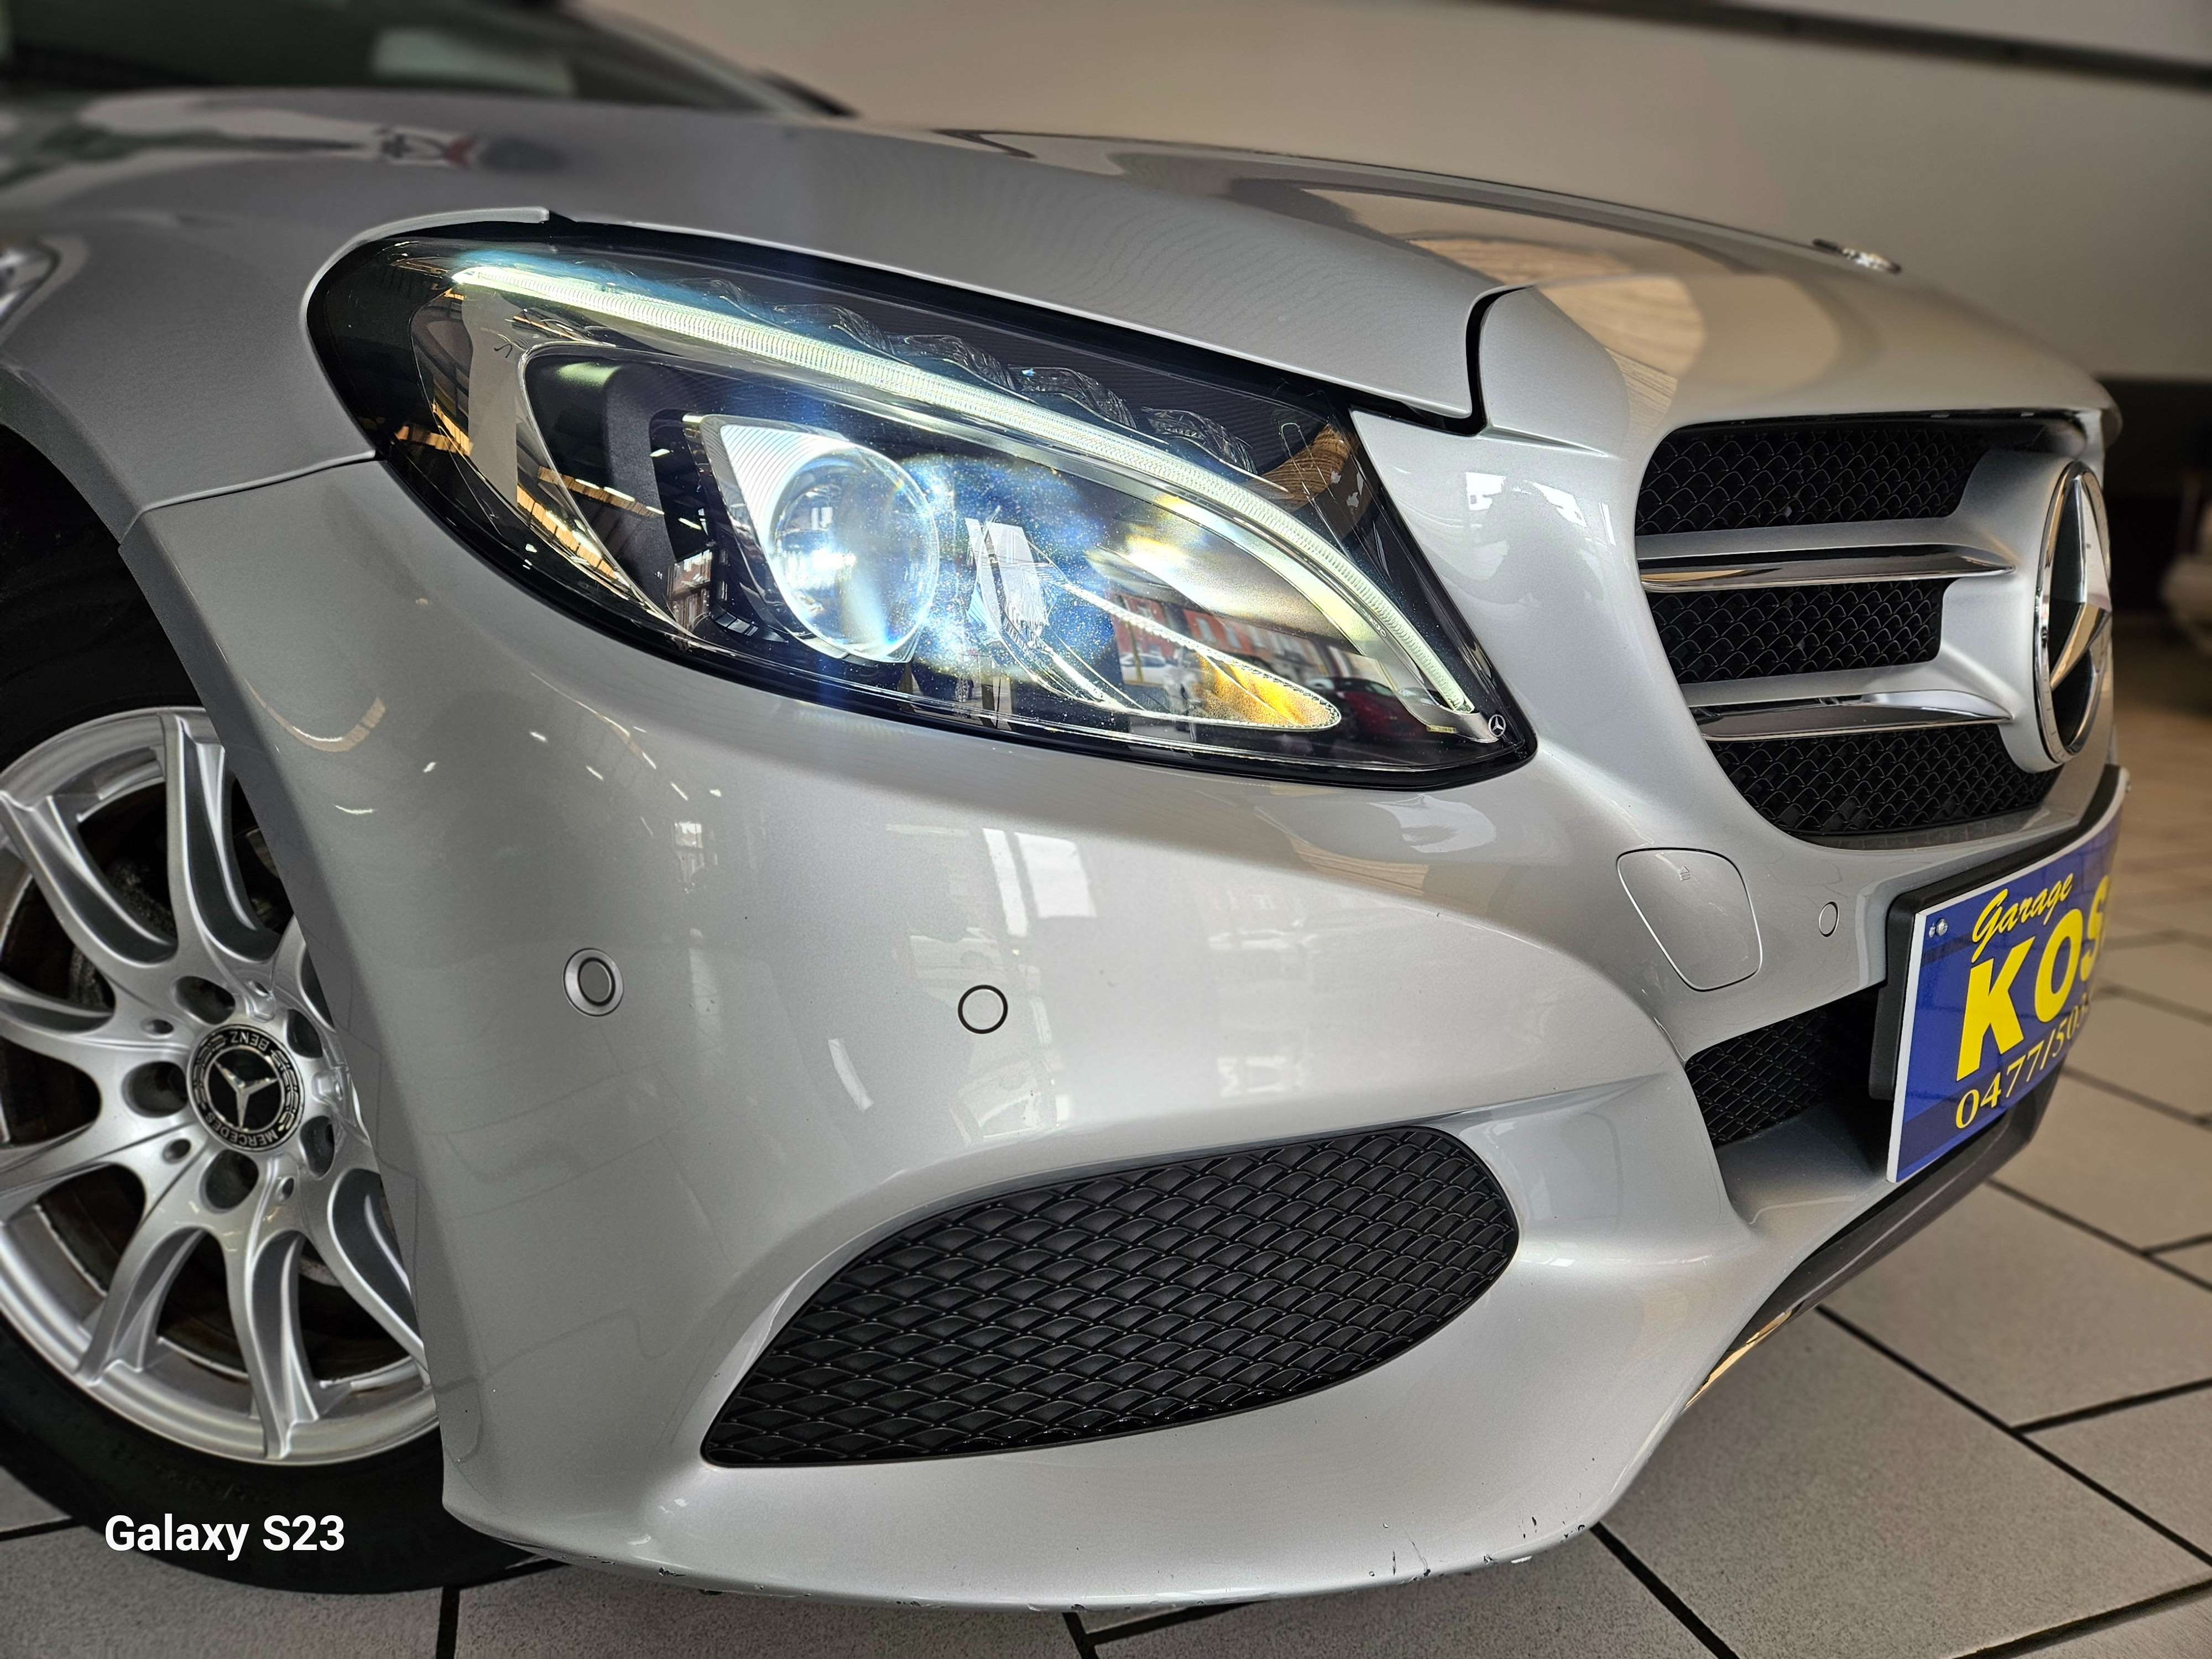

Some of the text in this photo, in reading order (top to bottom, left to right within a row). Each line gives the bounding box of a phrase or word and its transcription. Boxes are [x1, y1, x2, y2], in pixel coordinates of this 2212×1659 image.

[1971, 873, 2074, 963] Garage
[229, 1031, 270, 1052] BENZ
[205, 1112, 279, 1147] MERCEDES
